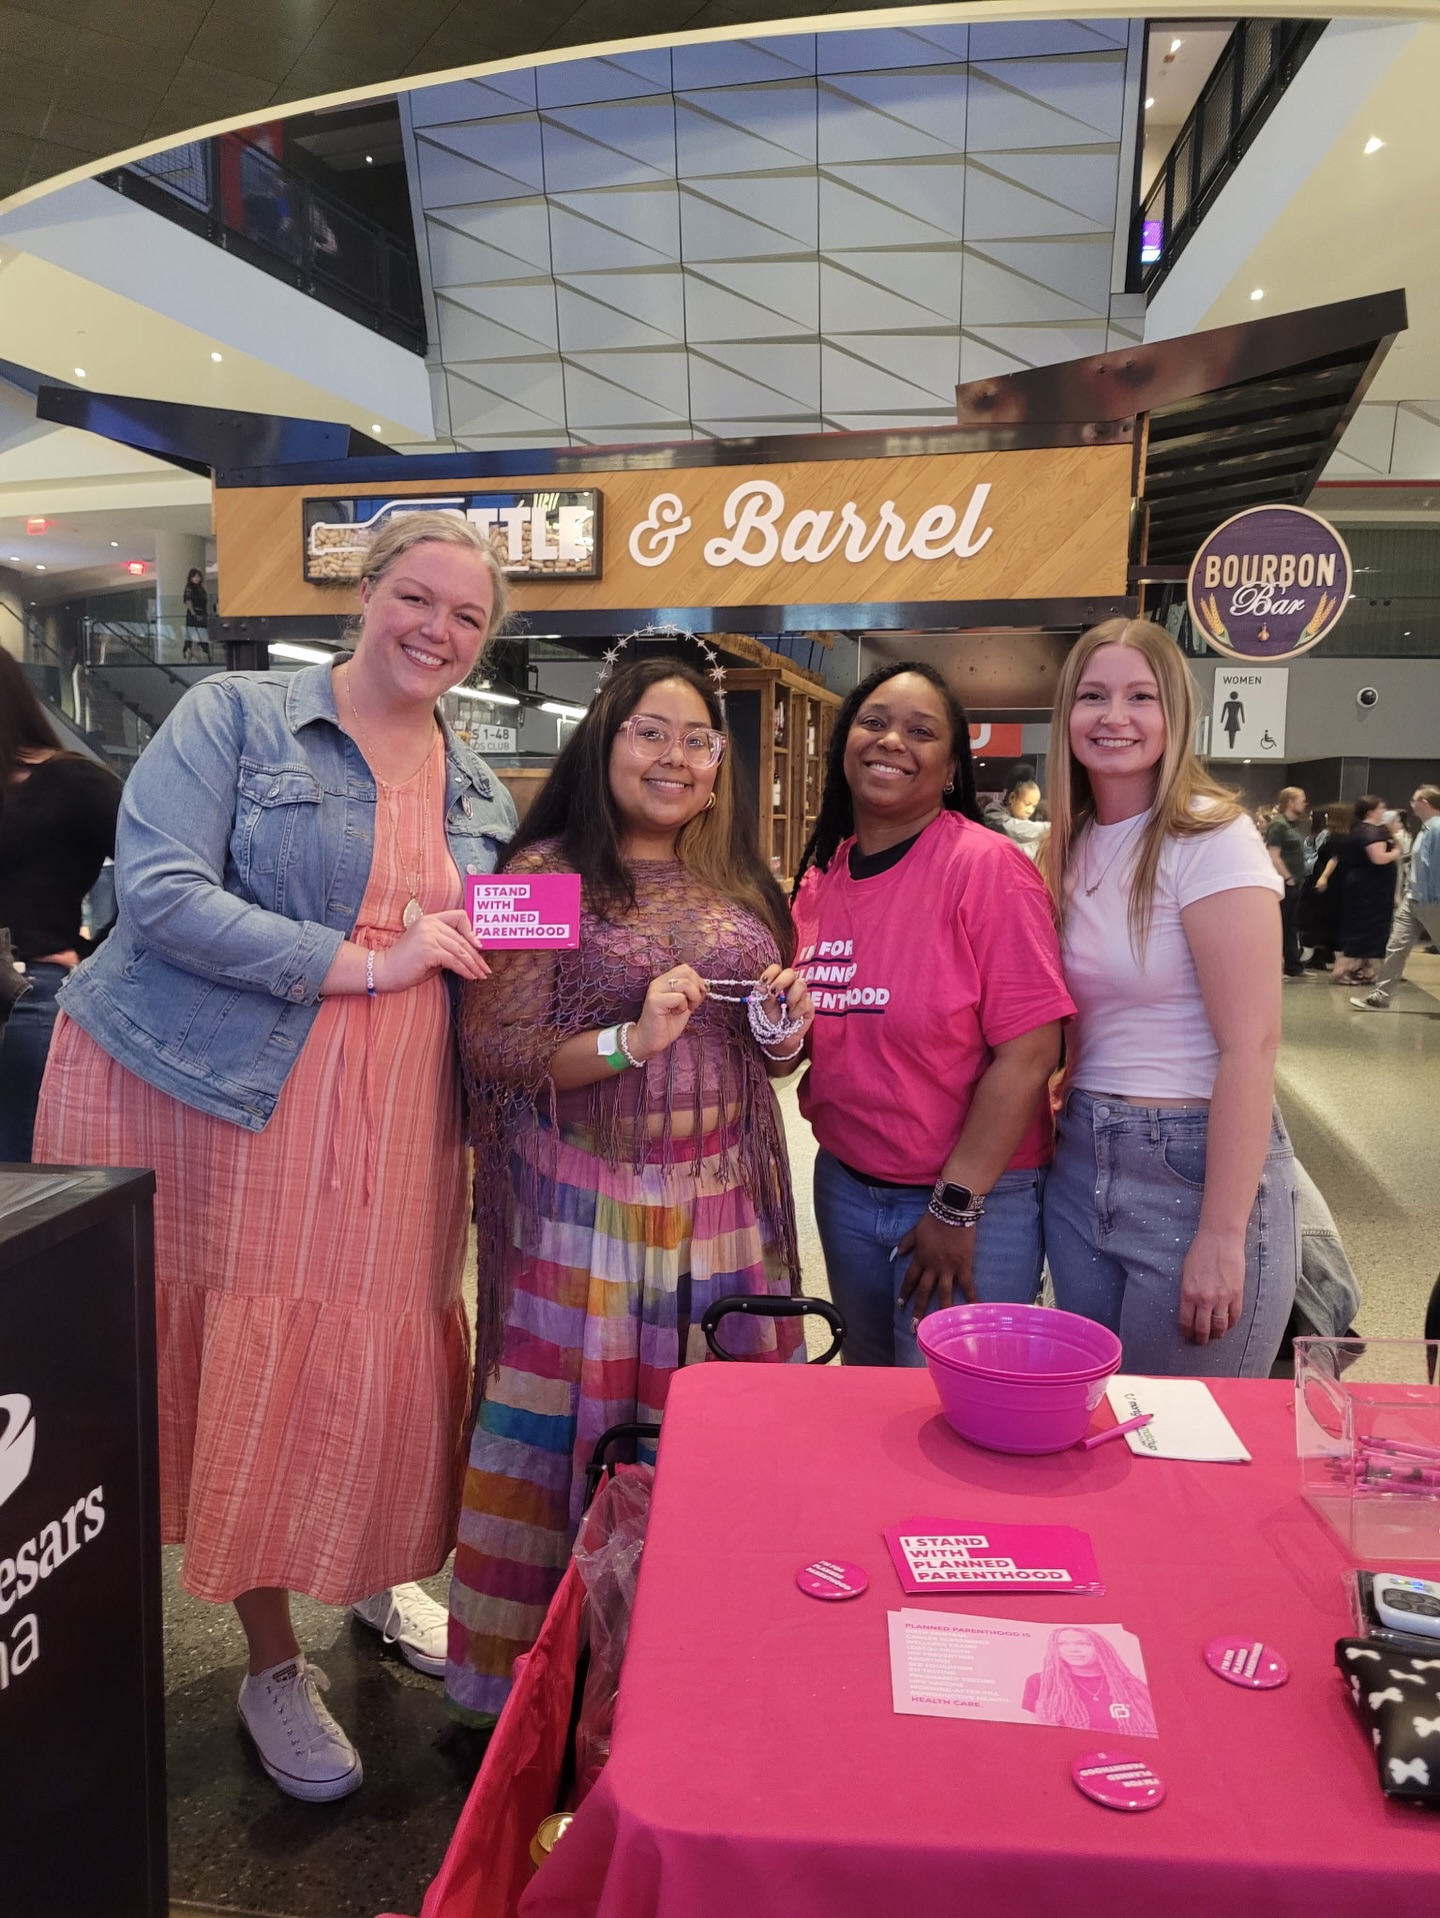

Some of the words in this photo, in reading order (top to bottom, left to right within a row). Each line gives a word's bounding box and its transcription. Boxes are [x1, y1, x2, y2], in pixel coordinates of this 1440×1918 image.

[391, 506, 588, 561] TTLE
[629, 492, 692, 567] &
[704, 480, 994, 567] Barrel
[1204, 553, 1337, 589] BOURBON
[1229, 581, 1306, 616] Bar
[1223, 676, 1262, 685] WOMEN
[484, 728, 509, 740] 1-48
[488, 742, 510, 751] CLUB
[476, 887, 480, 896] I
[484, 887, 527, 896] STAND
[477, 900, 511, 910] WITH
[476, 913, 536, 923] PLANNED
[475, 926, 566, 937] PARENTHOOD
[904, 1539, 910, 1547] I
[916, 1538, 983, 1547] STAND
[910, 1549, 965, 1558] WITH
[913, 1559, 1010, 1569] PLANNED
[917, 1571, 1064, 1581] PARENTHOOD
[905, 1623, 950, 1631] PLANNED
[953, 1628, 1020, 1636] PARENTHOOD
